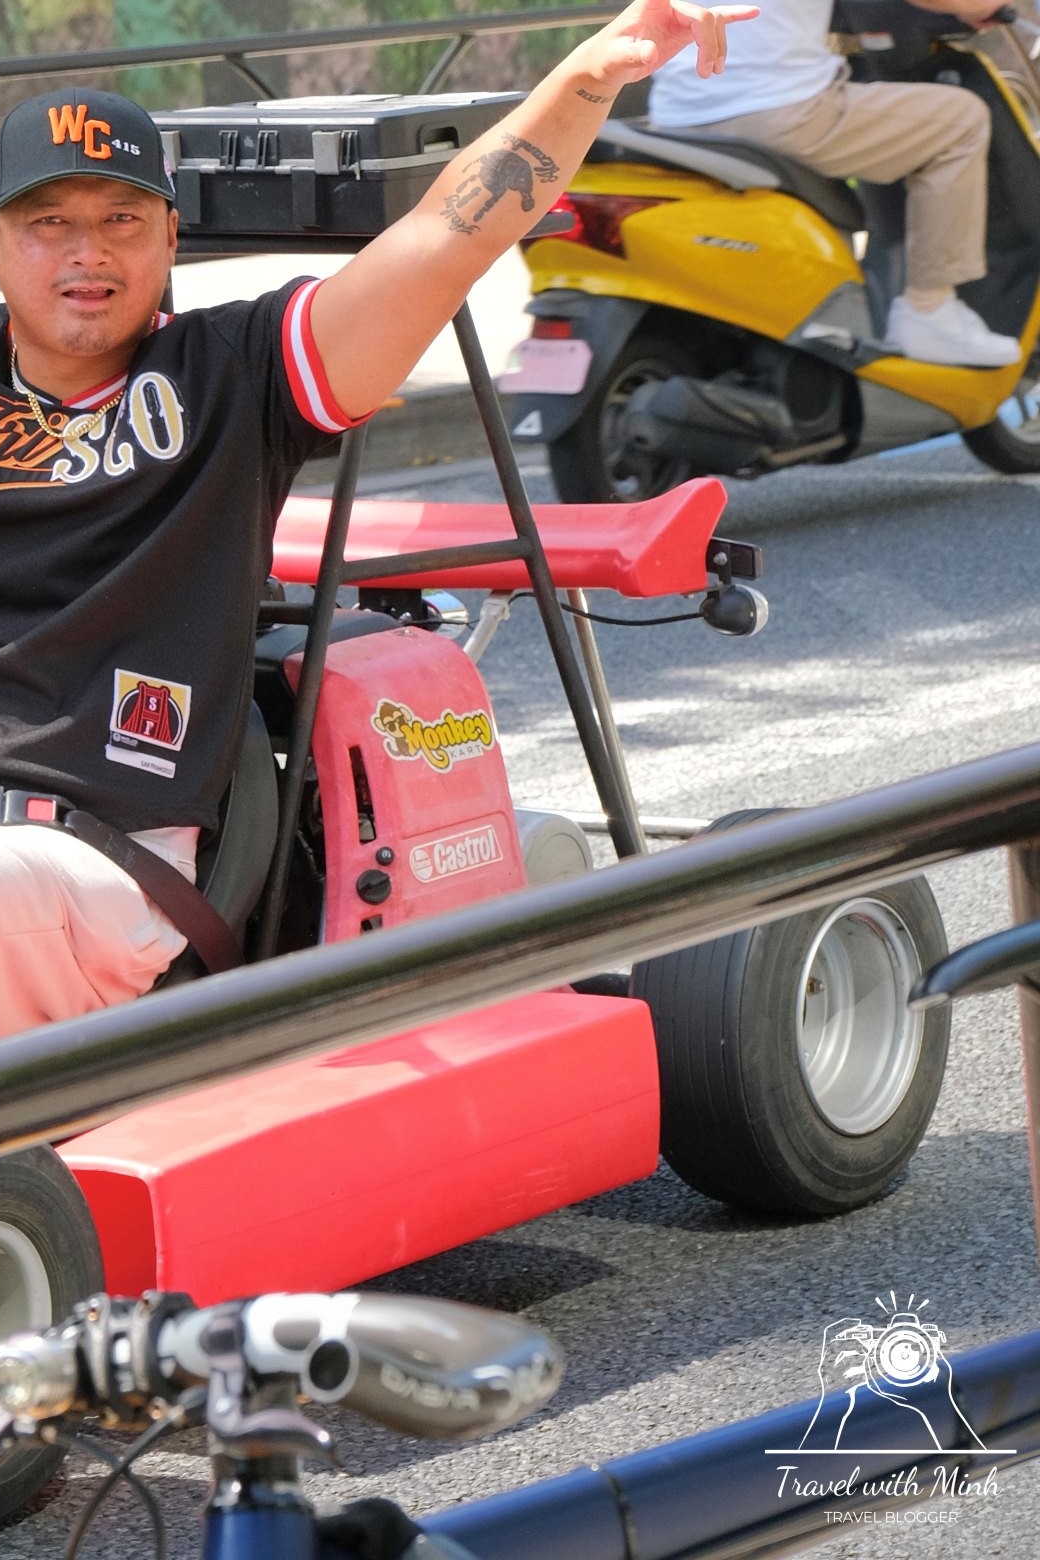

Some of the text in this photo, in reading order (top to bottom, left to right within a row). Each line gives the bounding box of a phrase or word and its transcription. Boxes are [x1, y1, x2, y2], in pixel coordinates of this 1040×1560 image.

[47, 103, 141, 160] WC 415
[400, 712, 492, 769] Monkey
[450, 745, 482, 759] KART
[433, 828, 497, 875] Castrol
